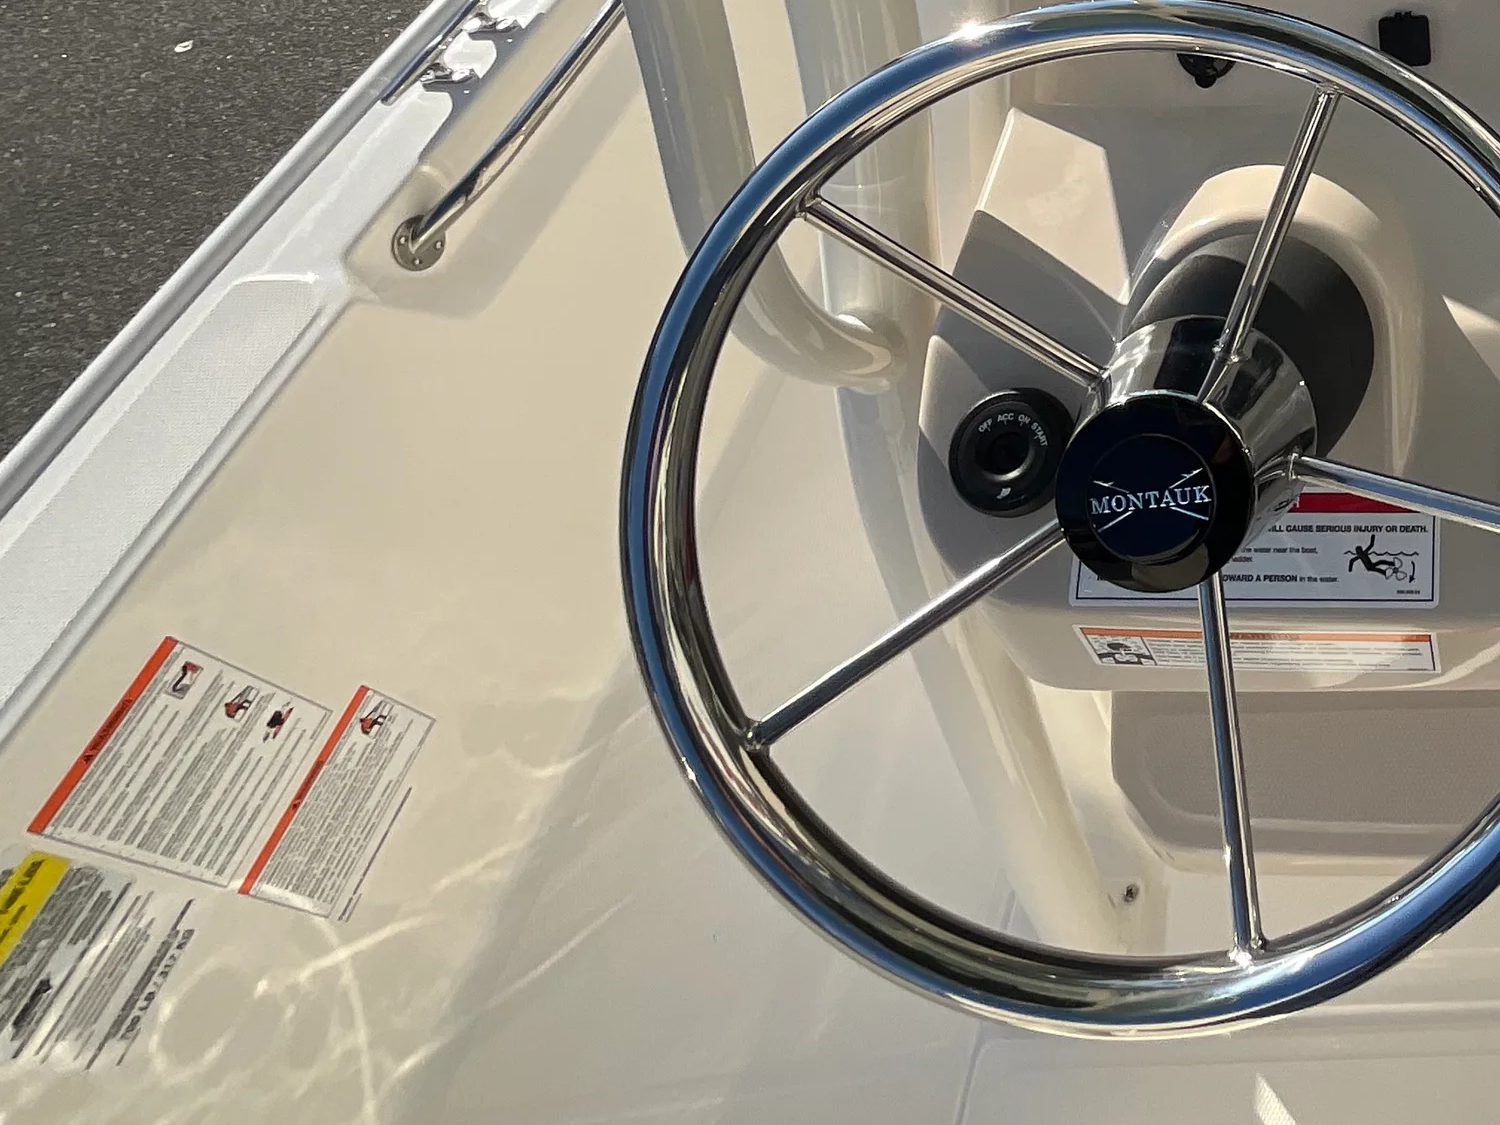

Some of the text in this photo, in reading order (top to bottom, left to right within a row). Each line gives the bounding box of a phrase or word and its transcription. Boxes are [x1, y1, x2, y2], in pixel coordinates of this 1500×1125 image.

[978, 412, 1049, 446] OFF ACC ON START
[1090, 485, 1212, 515] MONTAUK
[1268, 525, 1428, 533] ILL CAUSE SERIOUS INJURY OR DEATH.
[1222, 574, 1254, 582] OWARD
[1255, 574, 1262, 582] A
[1263, 574, 1297, 583] PERSON
[1307, 575, 1317, 583] the
